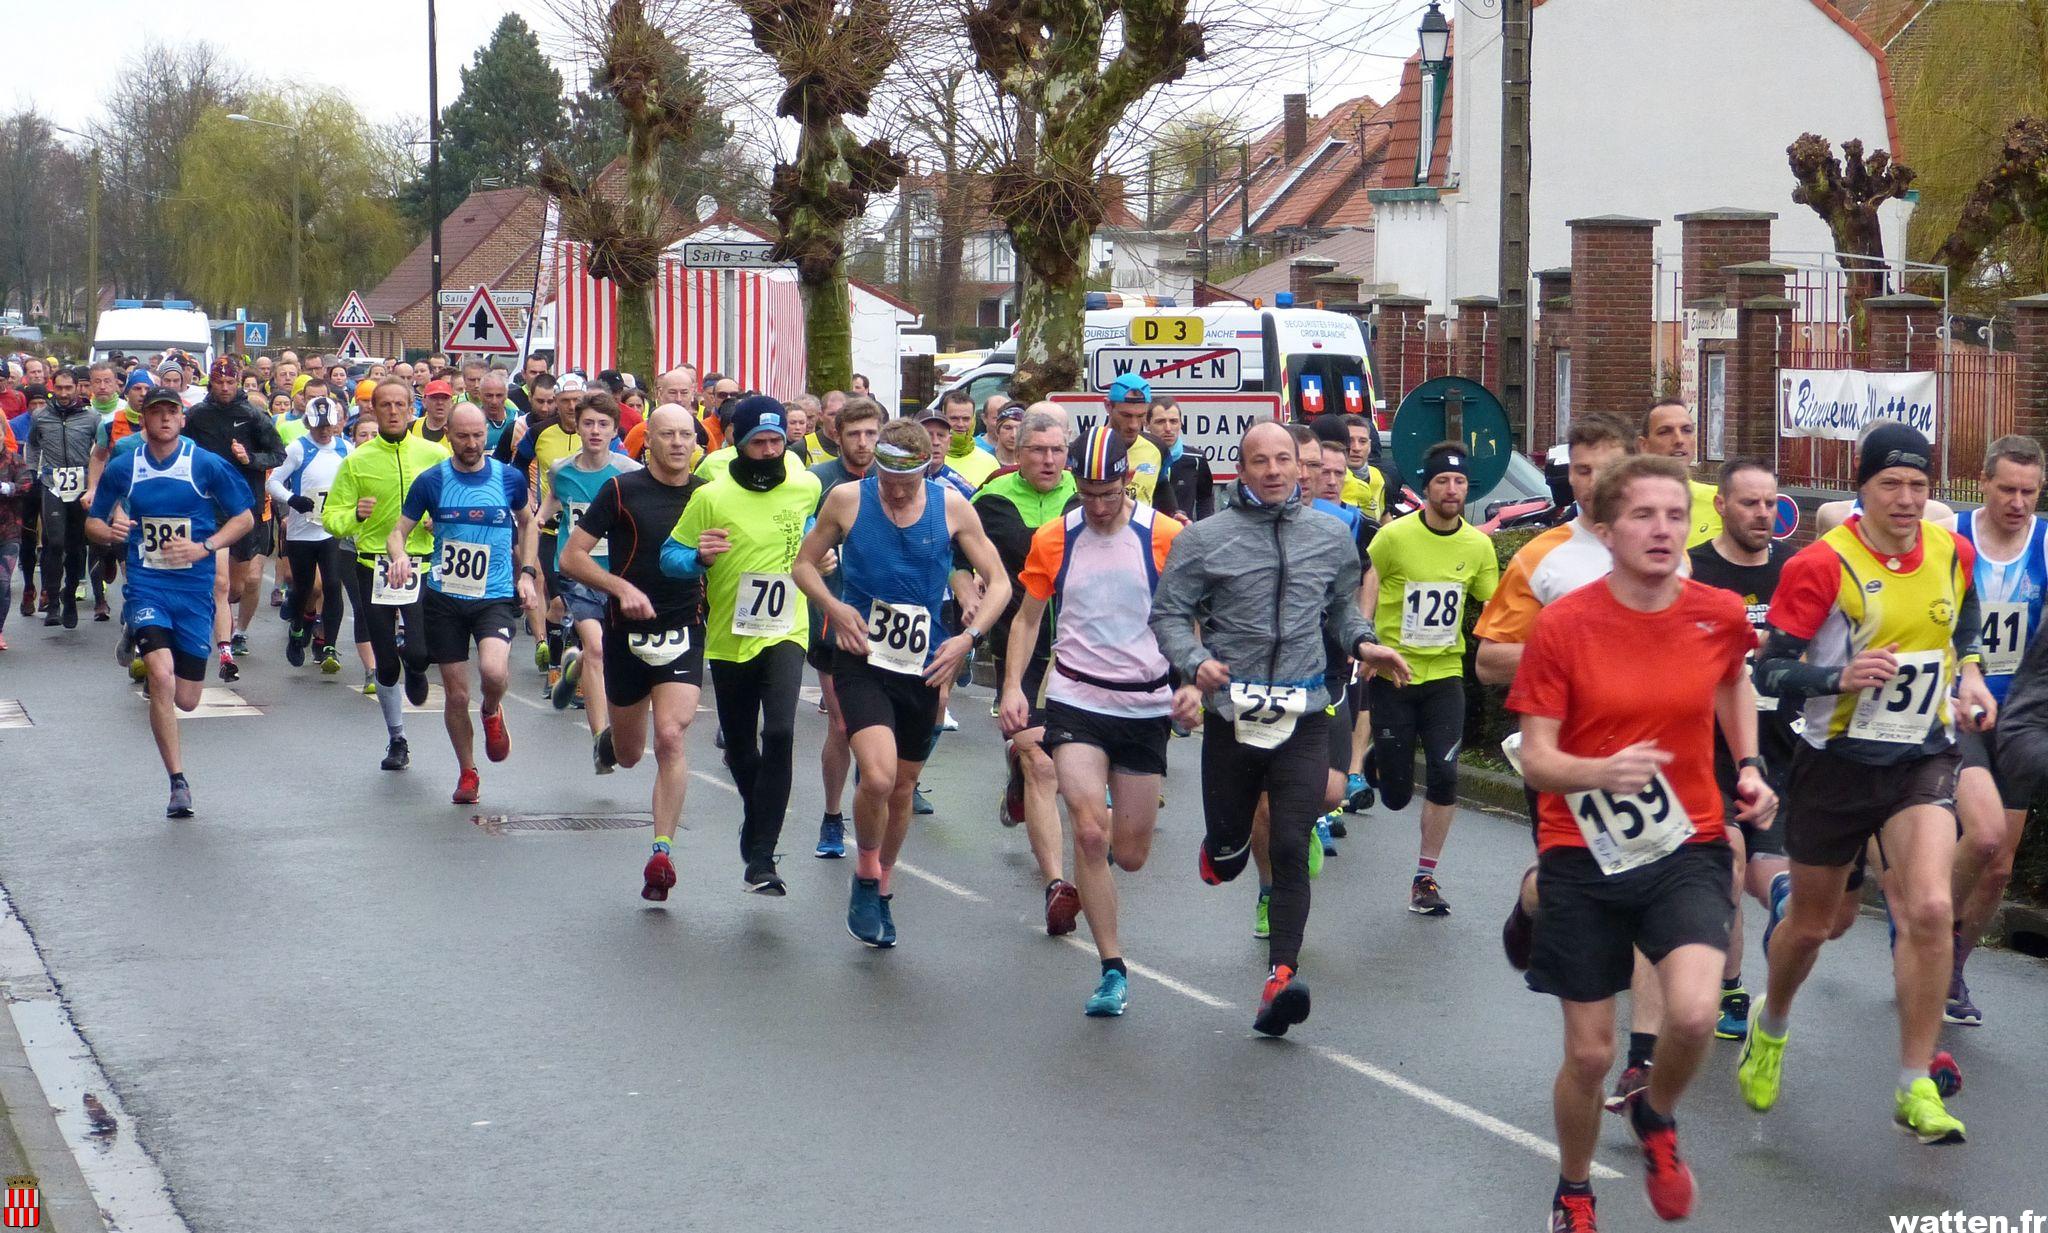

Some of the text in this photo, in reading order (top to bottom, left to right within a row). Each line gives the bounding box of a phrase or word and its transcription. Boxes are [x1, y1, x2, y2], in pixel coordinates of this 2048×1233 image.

[691, 249, 731, 262] Salle
[445, 294, 468, 303] Salle
[1084, 329, 1125, 338] OURISTES
[1144, 320, 1187, 341] D 3
[1205, 329, 1236, 338] ANCHE
[1112, 358, 1225, 379] WATTEN
[59, 471, 78, 492] 23
[440, 544, 487, 581] 380
[750, 579, 786, 618] 70
[1407, 589, 1459, 627] 128
[868, 605, 927, 654] 386
[1239, 694, 1289, 724] 25
[1579, 777, 1670, 846] 159
